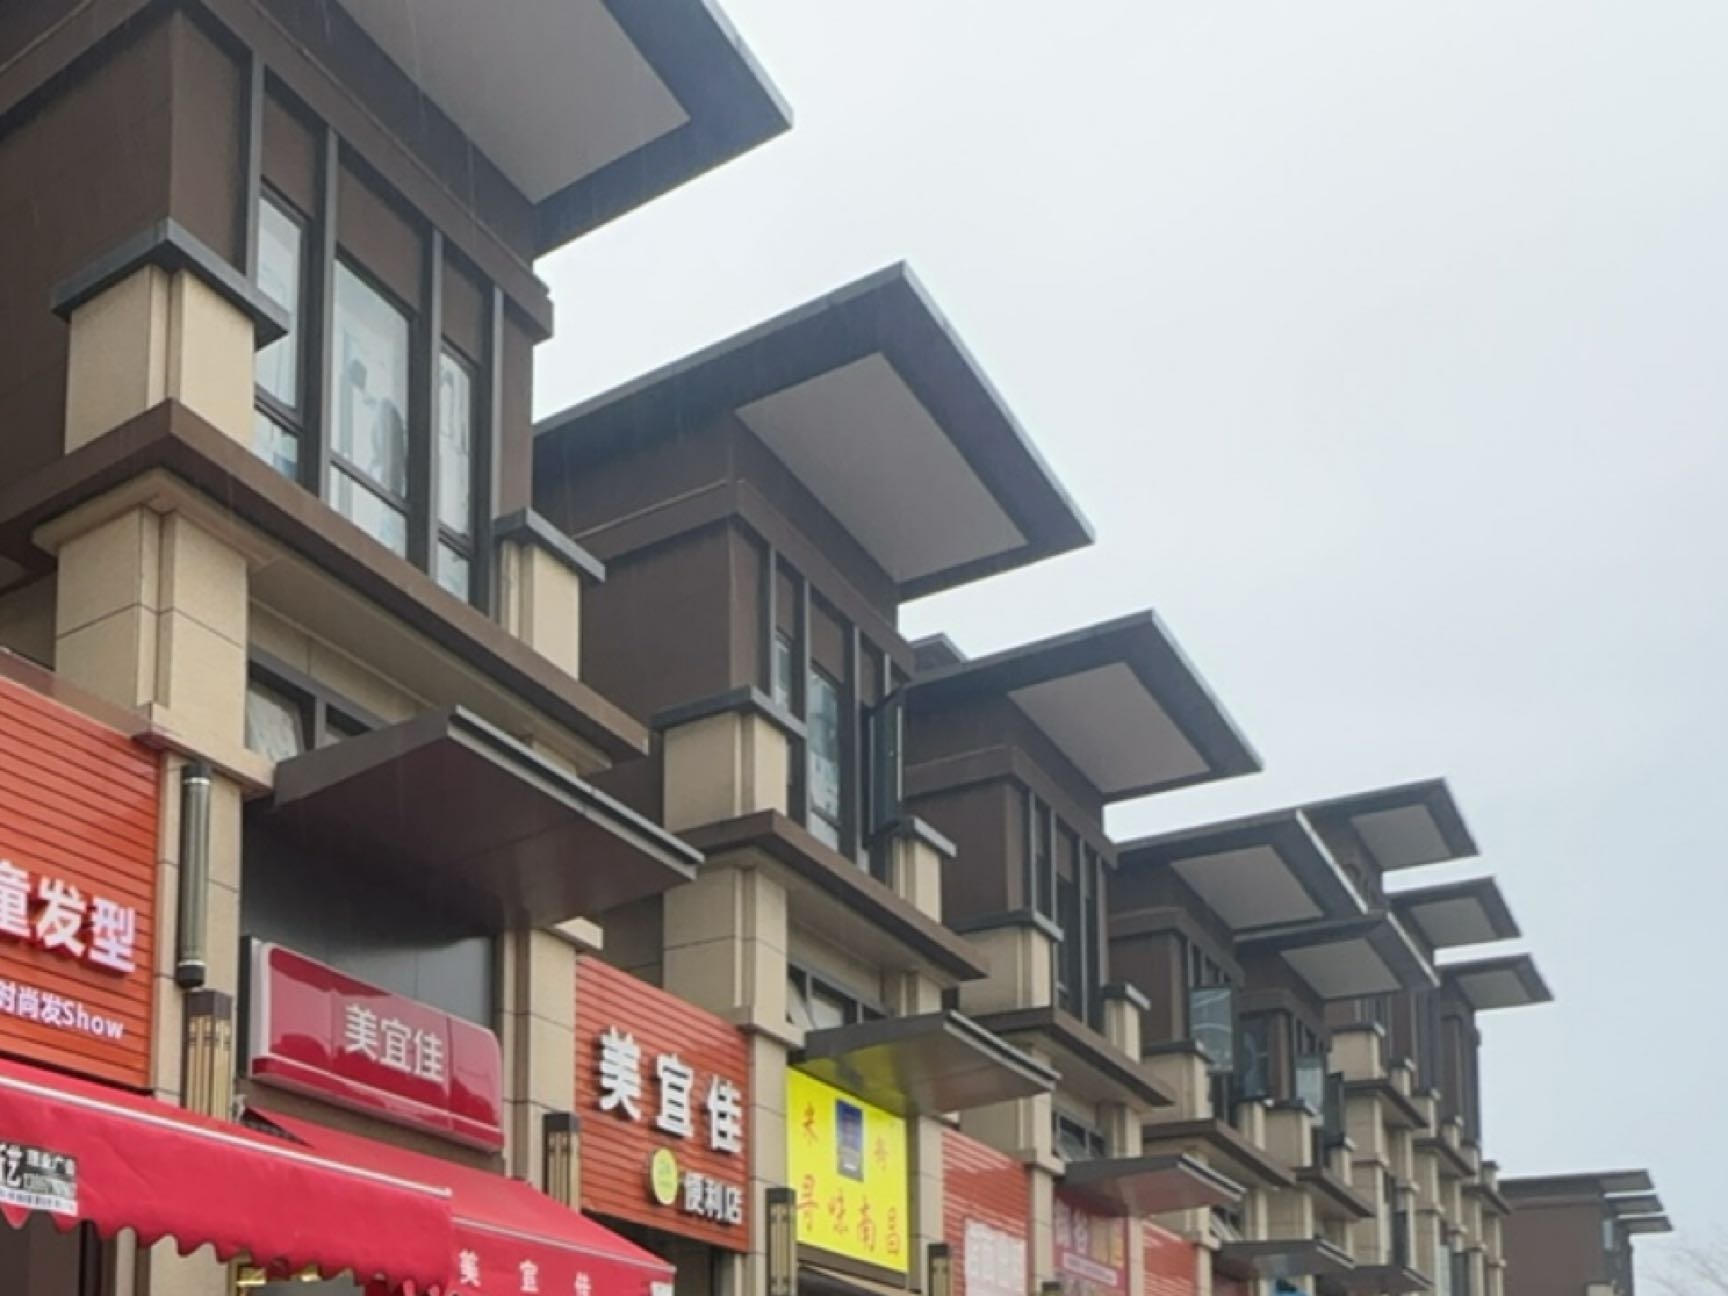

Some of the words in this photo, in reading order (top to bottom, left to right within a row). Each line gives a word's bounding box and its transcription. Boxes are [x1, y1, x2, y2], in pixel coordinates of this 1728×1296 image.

[345, 1003, 444, 1083] 美宜佳
[599, 1024, 743, 1153] 美宜佳
[684, 1172, 743, 1224] 便利店
